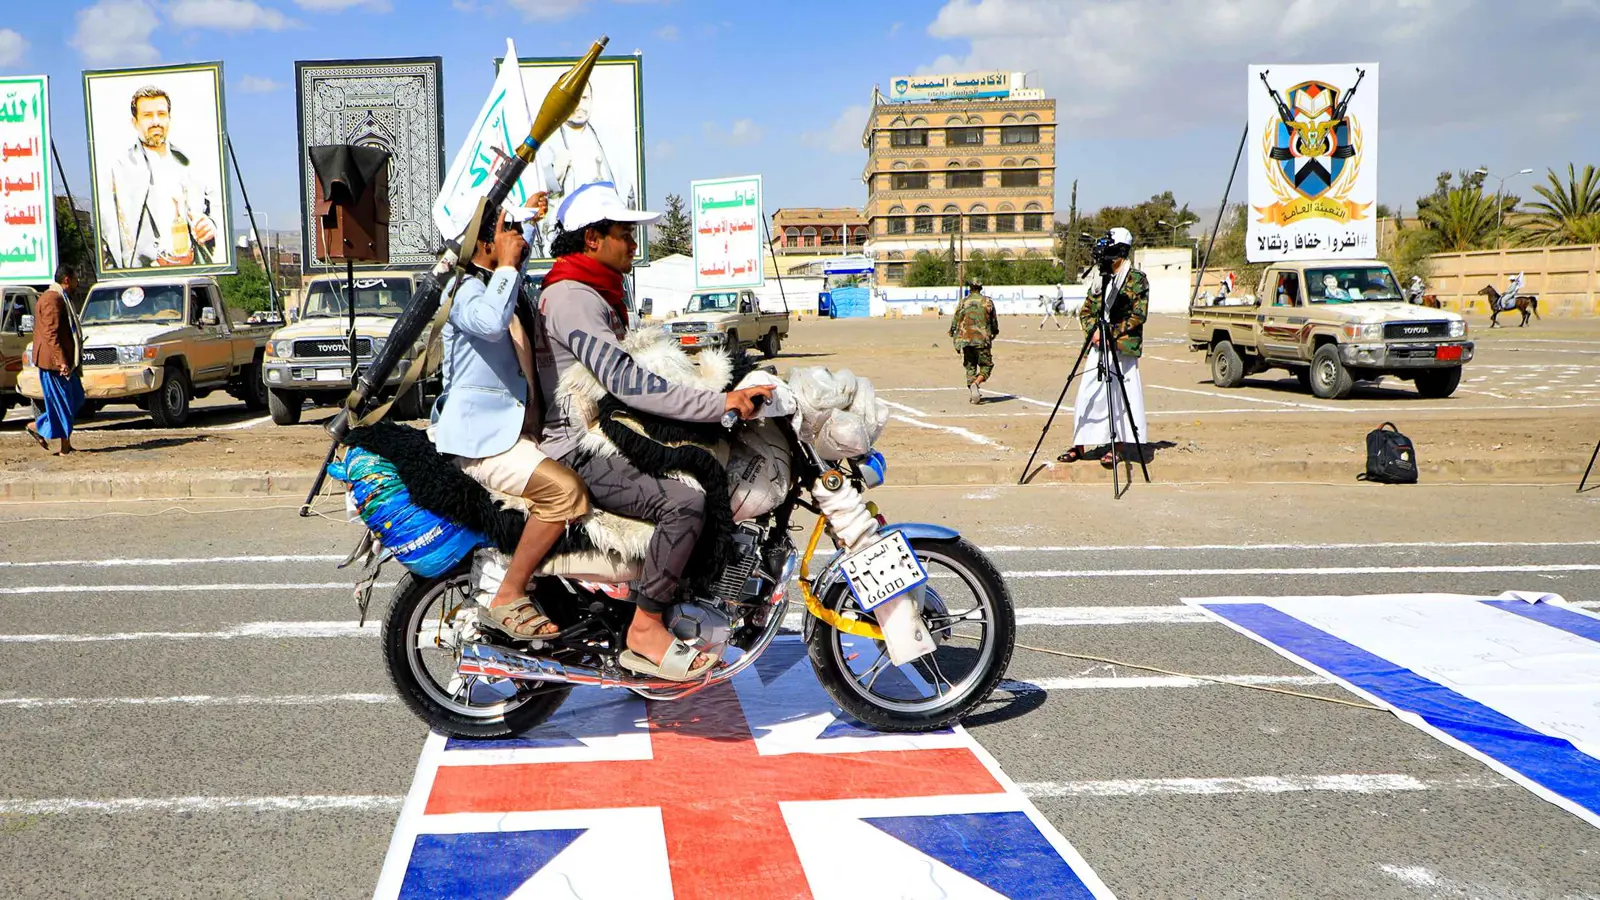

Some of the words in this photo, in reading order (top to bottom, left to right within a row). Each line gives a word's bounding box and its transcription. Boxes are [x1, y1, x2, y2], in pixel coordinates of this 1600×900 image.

[911, 77, 949, 91] اليمنية
[953, 73, 1006, 87] الأكاديمية
[2, 137, 39, 163] المو
[0, 171, 41, 197] المو
[4, 204, 42, 225] اللعنة
[1282, 203, 1313, 222] العامة
[1314, 202, 1346, 219] التعبئة
[1403, 326, 1429, 334] TOYOTA
[317, 344, 348, 352] TOYOTA
[864, 543, 890, 566] اليمن
[892, 536, 920, 578] YEMEN
